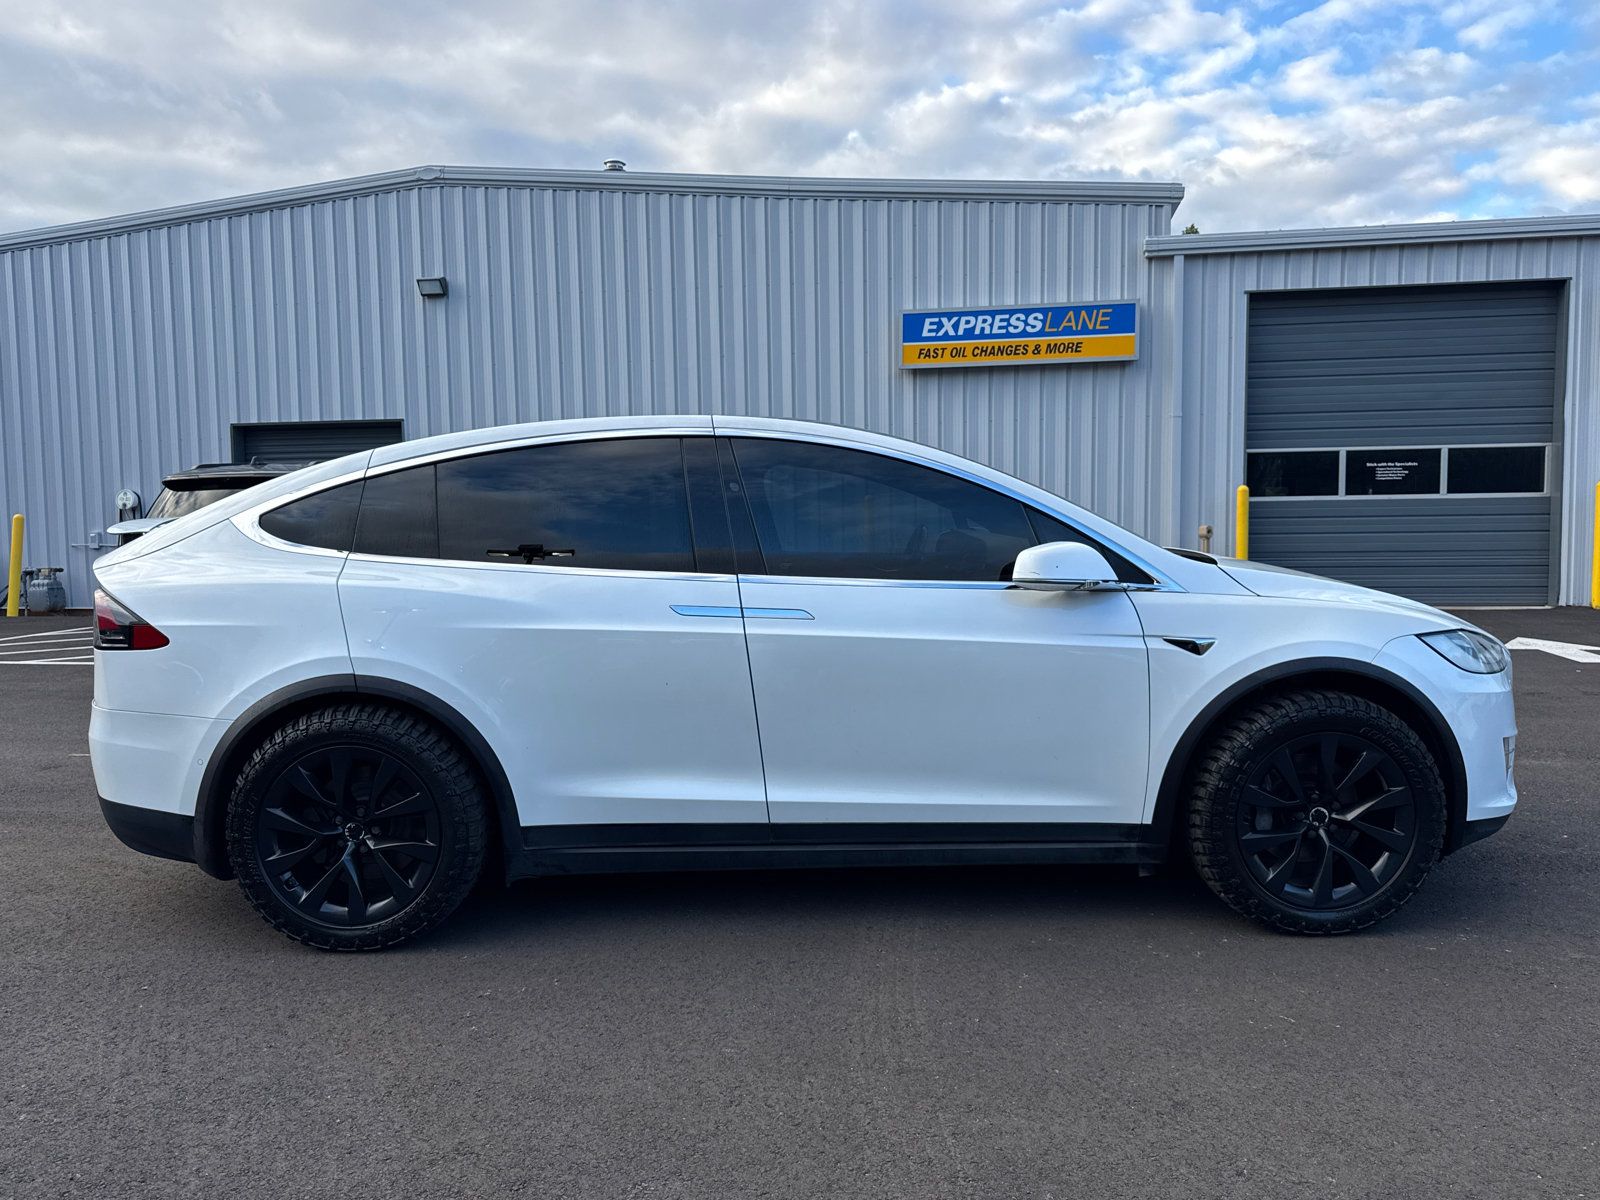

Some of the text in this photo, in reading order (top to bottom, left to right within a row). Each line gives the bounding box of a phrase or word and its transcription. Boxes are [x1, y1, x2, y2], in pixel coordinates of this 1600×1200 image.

[917, 341, 1083, 359] FAST OIL CHANGES & MORE
